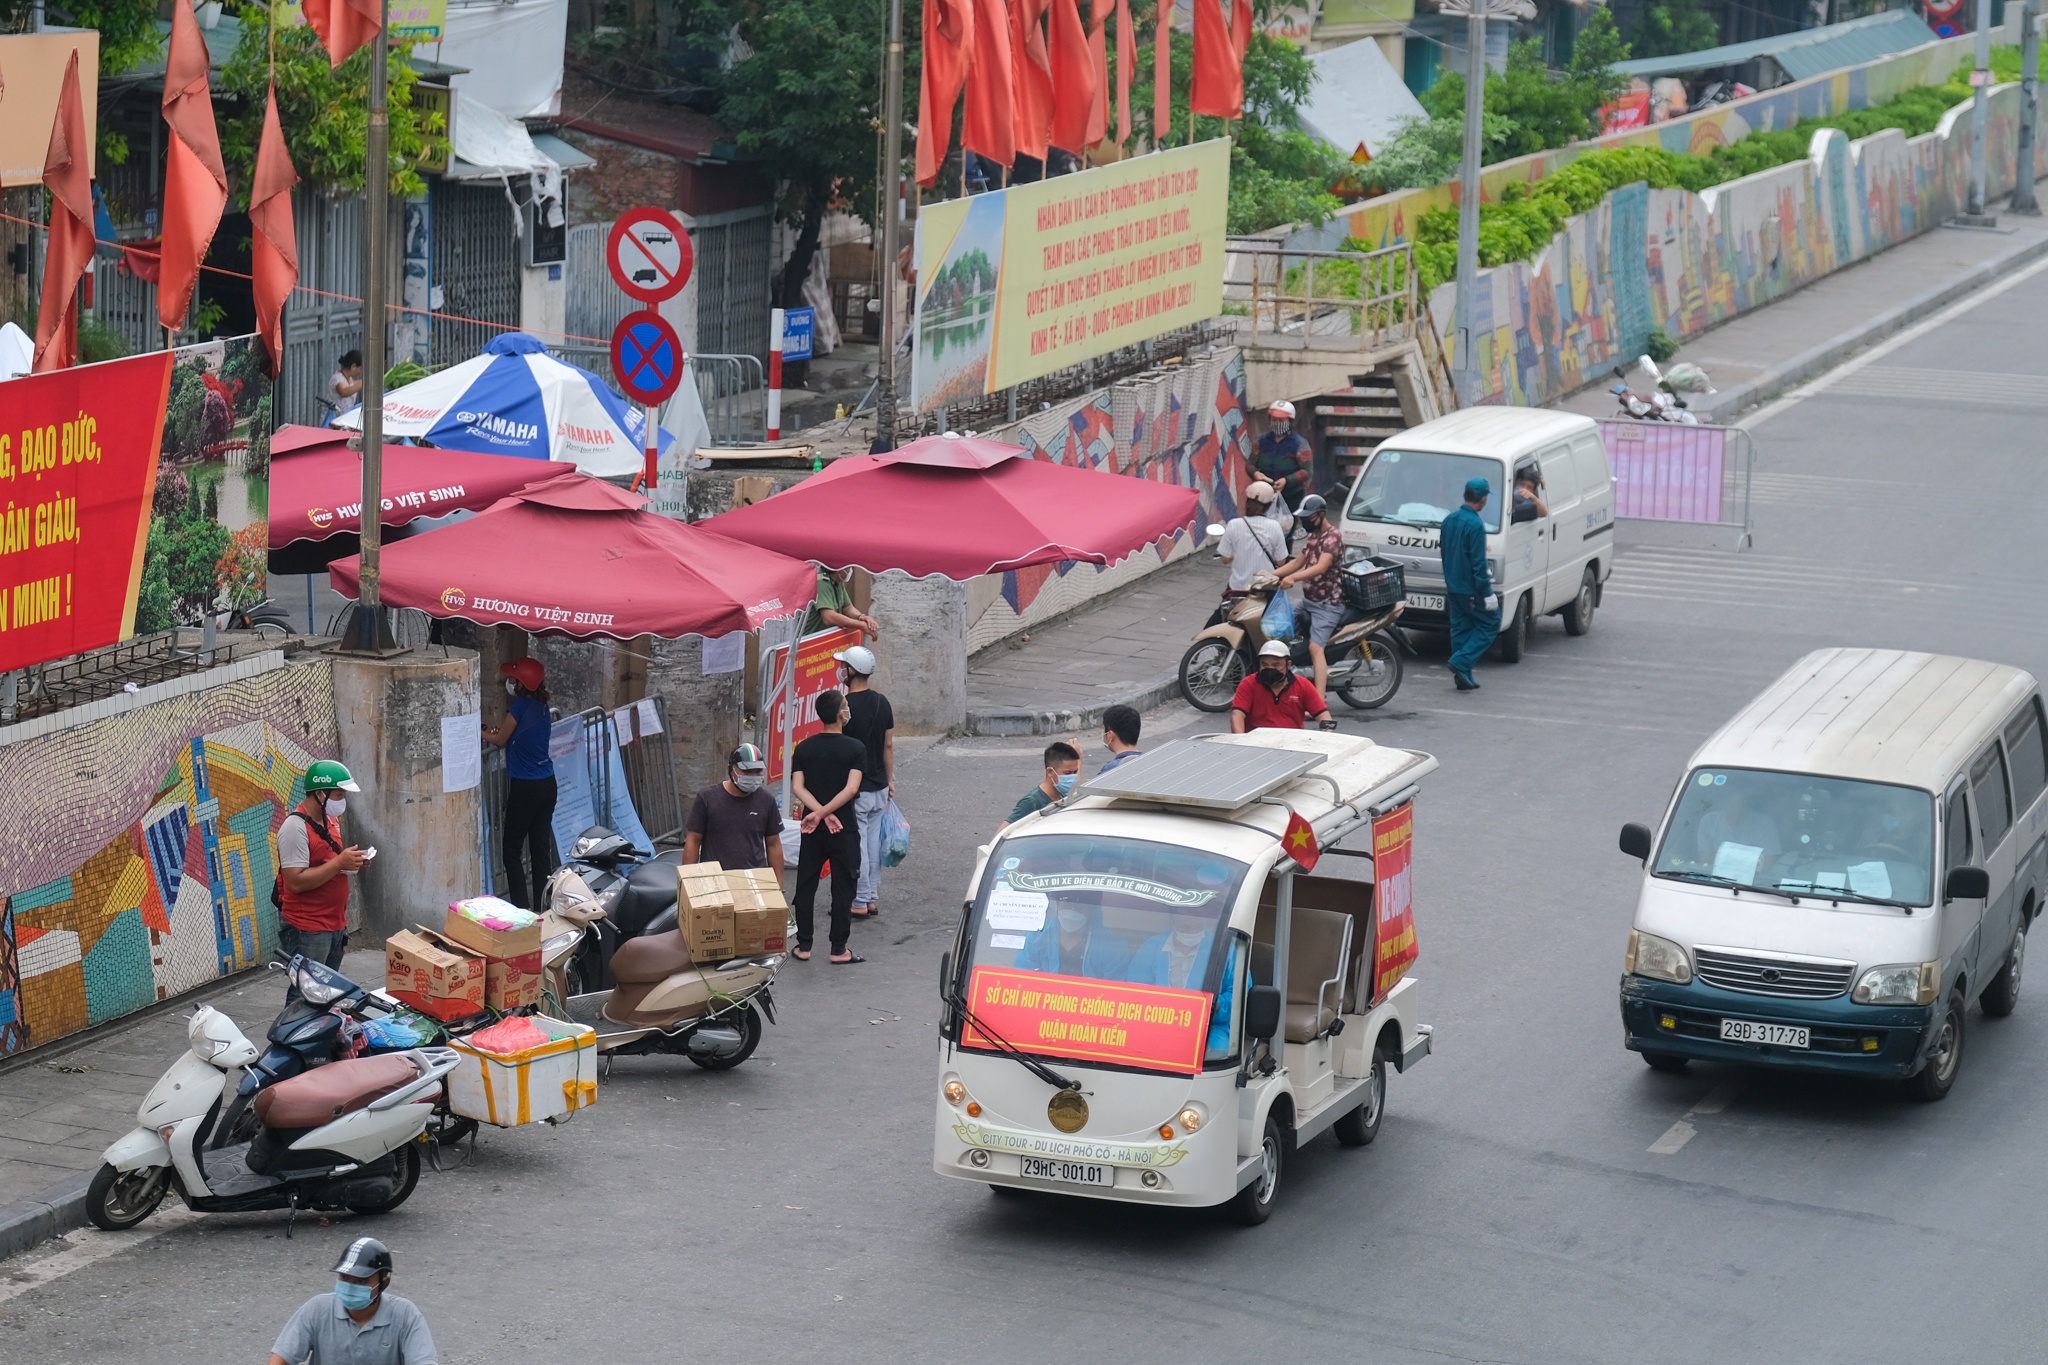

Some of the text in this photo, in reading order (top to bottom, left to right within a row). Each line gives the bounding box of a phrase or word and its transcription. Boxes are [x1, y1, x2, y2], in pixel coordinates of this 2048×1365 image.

[1037, 200, 1057, 232] NHÂN
[1059, 195, 1073, 226] DÂN
[1074, 191, 1083, 222] VÀ
[1085, 189, 1099, 219] CÁN
[1111, 179, 1138, 212] PHƯỜNG
[1139, 174, 1156, 205] PHÚC
[1043, 243, 1062, 271] THAM
[1064, 239, 1076, 265] GIA
[1078, 230, 1091, 262] CÁC
[1093, 229, 1115, 257] PHONG
[1117, 219, 1133, 250] TRÀO
[1135, 220, 1144, 245] THI
[1027, 280, 1048, 318] QUYẾT
[1050, 279, 1065, 309] TÂM
[1031, 327, 1048, 356] KINH
[1049, 316, 1058, 350] TẾ
[1063, 315, 1073, 346] XÃ
[1075, 311, 1087, 346] HỘI
[1093, 300, 1110, 338] QUỐC
[1112, 297, 1134, 330] PHÒNG
[1135, 296, 1144, 320] AN
[465, 425, 490, 440] Revs
[474, 412, 539, 440] YAMAHA
[564, 423, 615, 445] YAMAHA
[21, 424, 57, 480] ĐẠO
[61, 410, 101, 466] ĐỨC,
[336, 485, 466, 520] HƯG VIỆT SINH
[35, 491, 81, 548] GIÀU,
[313, 512, 333, 523] HVS
[1388, 535, 1441, 550] SUZUK
[13, 575, 60, 629] MINH
[66, 573, 72, 617] !
[445, 594, 466, 606] HVS
[472, 597, 615, 626] HƯƠNG VIỆT SINH
[777, 686, 805, 734] CỐT
[312, 775, 332, 783] Grab
[1061, 876, 1072, 886] XE
[1135, 881, 1151, 893] MÔI
[389, 959, 411, 974] Karo
[470, 964, 481, 974] 20
[448, 979, 466, 991] Karo
[985, 980, 1192, 1028] SỞ CHỈ HUY PHÒNG CHỐNG DỊCH COVID-19
[1039, 1019, 1127, 1047] QUẬN HOÀN KIẾM
[982, 1132, 1002, 1146] CITY
[1004, 1136, 1028, 1148] TOUR
[1034, 1140, 1048, 1150] DU
[1049, 1142, 1071, 1156] LỊCH
[1072, 1142, 1096, 1157] PHỐ
[1095, 1145, 1112, 1160] CỔ
[1118, 1147, 1132, 1162] HÀ
[1134, 1149, 1152, 1166] NỘI
[1024, 1159, 1102, 1183] 29HC-001.01
